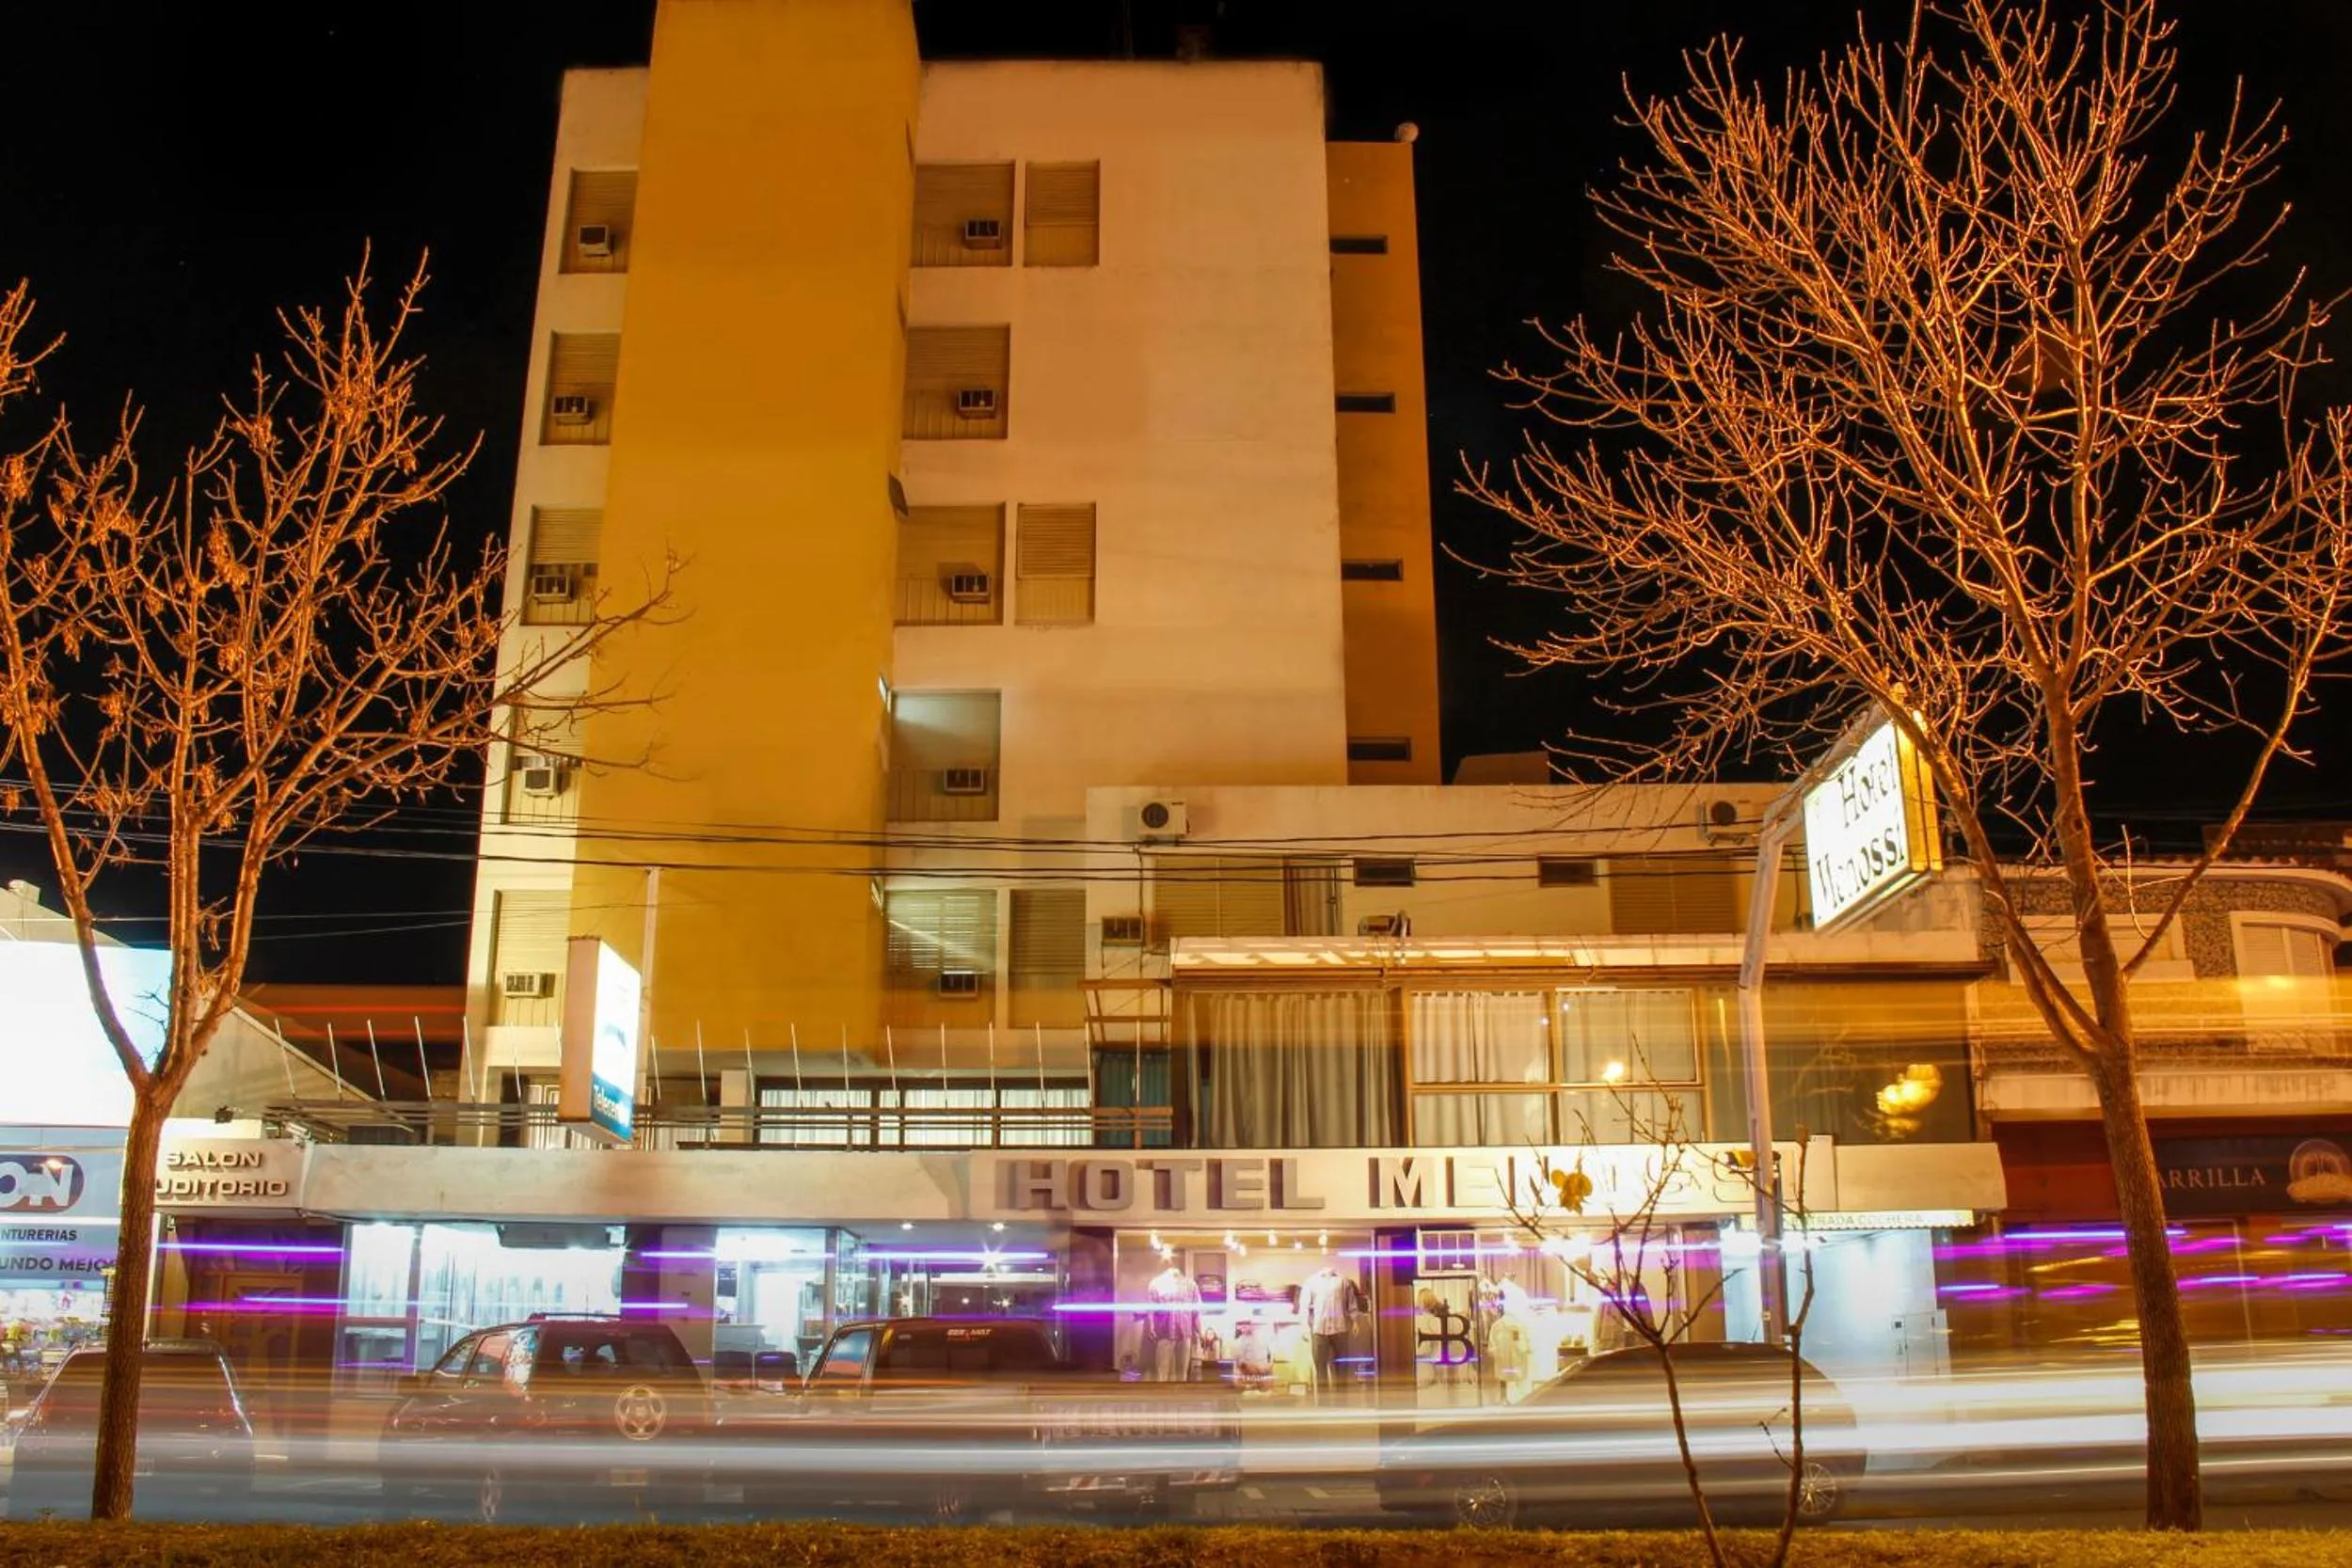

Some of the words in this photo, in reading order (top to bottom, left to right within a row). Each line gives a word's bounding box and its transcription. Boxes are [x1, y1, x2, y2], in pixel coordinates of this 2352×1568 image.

[1837, 742, 1898, 829] Hotel
[167, 1150, 262, 1169] SALON
[155, 1178, 288, 1197] UDITORIO
[995, 1159, 1326, 1211] HOTEL
[1369, 1155, 1801, 1211] MENSSI
